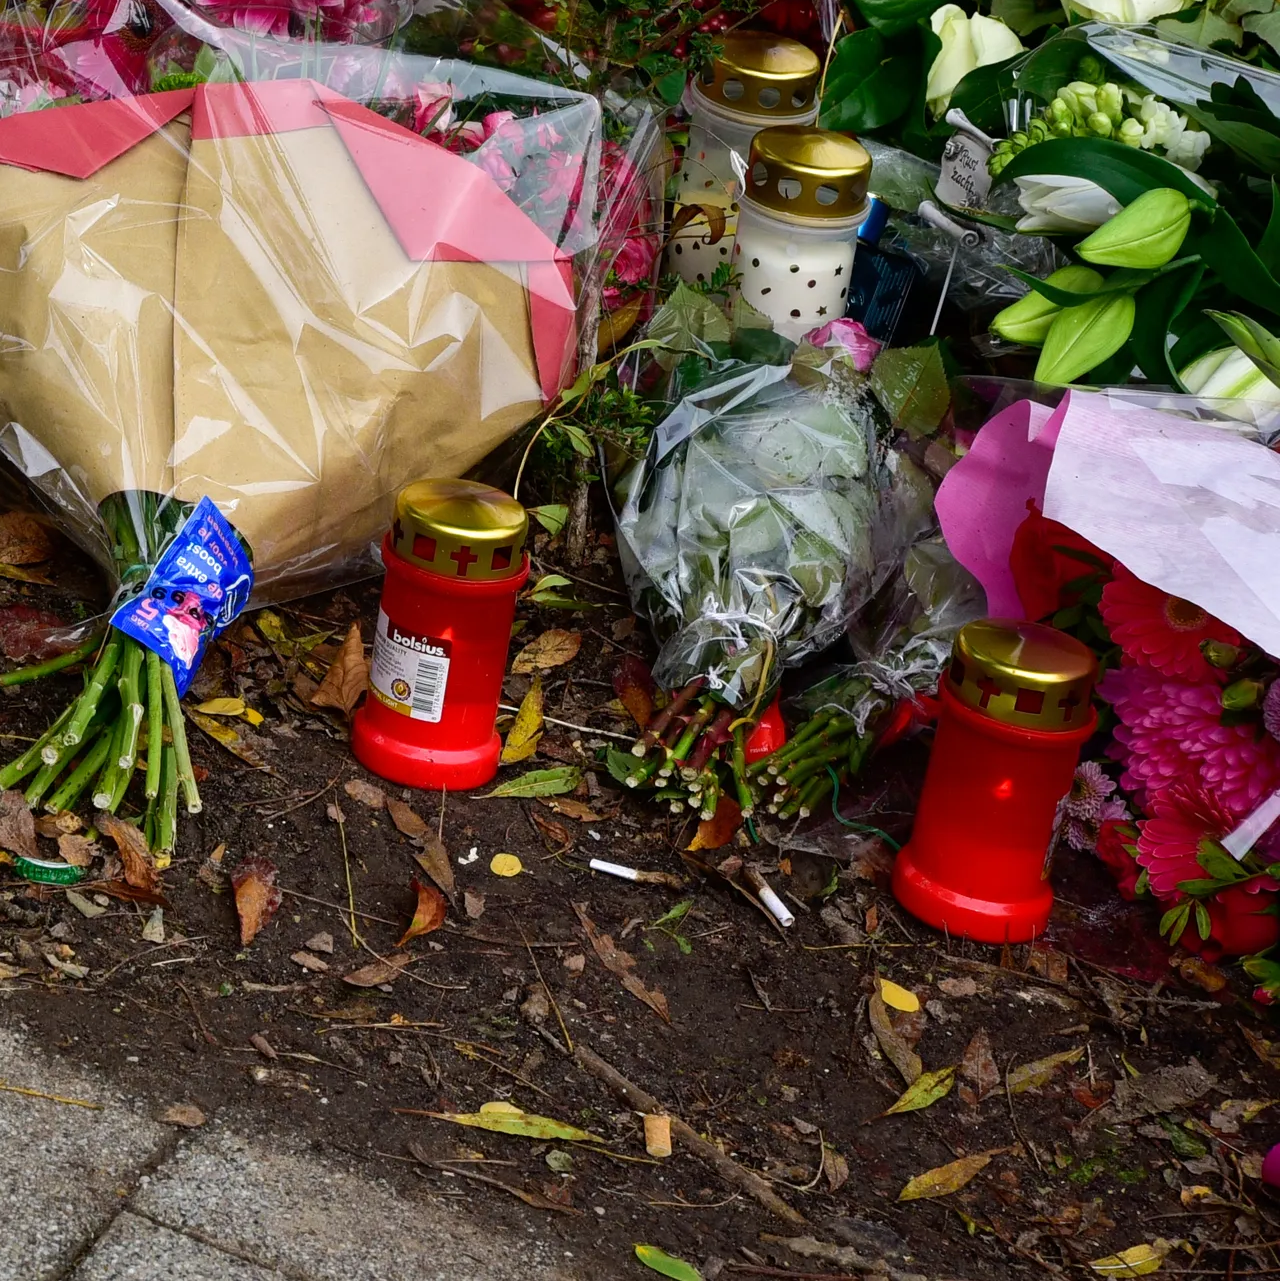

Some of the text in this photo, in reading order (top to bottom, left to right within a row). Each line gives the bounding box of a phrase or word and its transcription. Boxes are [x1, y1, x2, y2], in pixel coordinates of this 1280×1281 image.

[176, 555, 208, 584] extra
[185, 541, 223, 577] boost
[135, 598, 160, 621] 5
[393, 628, 445, 657] bolsius
